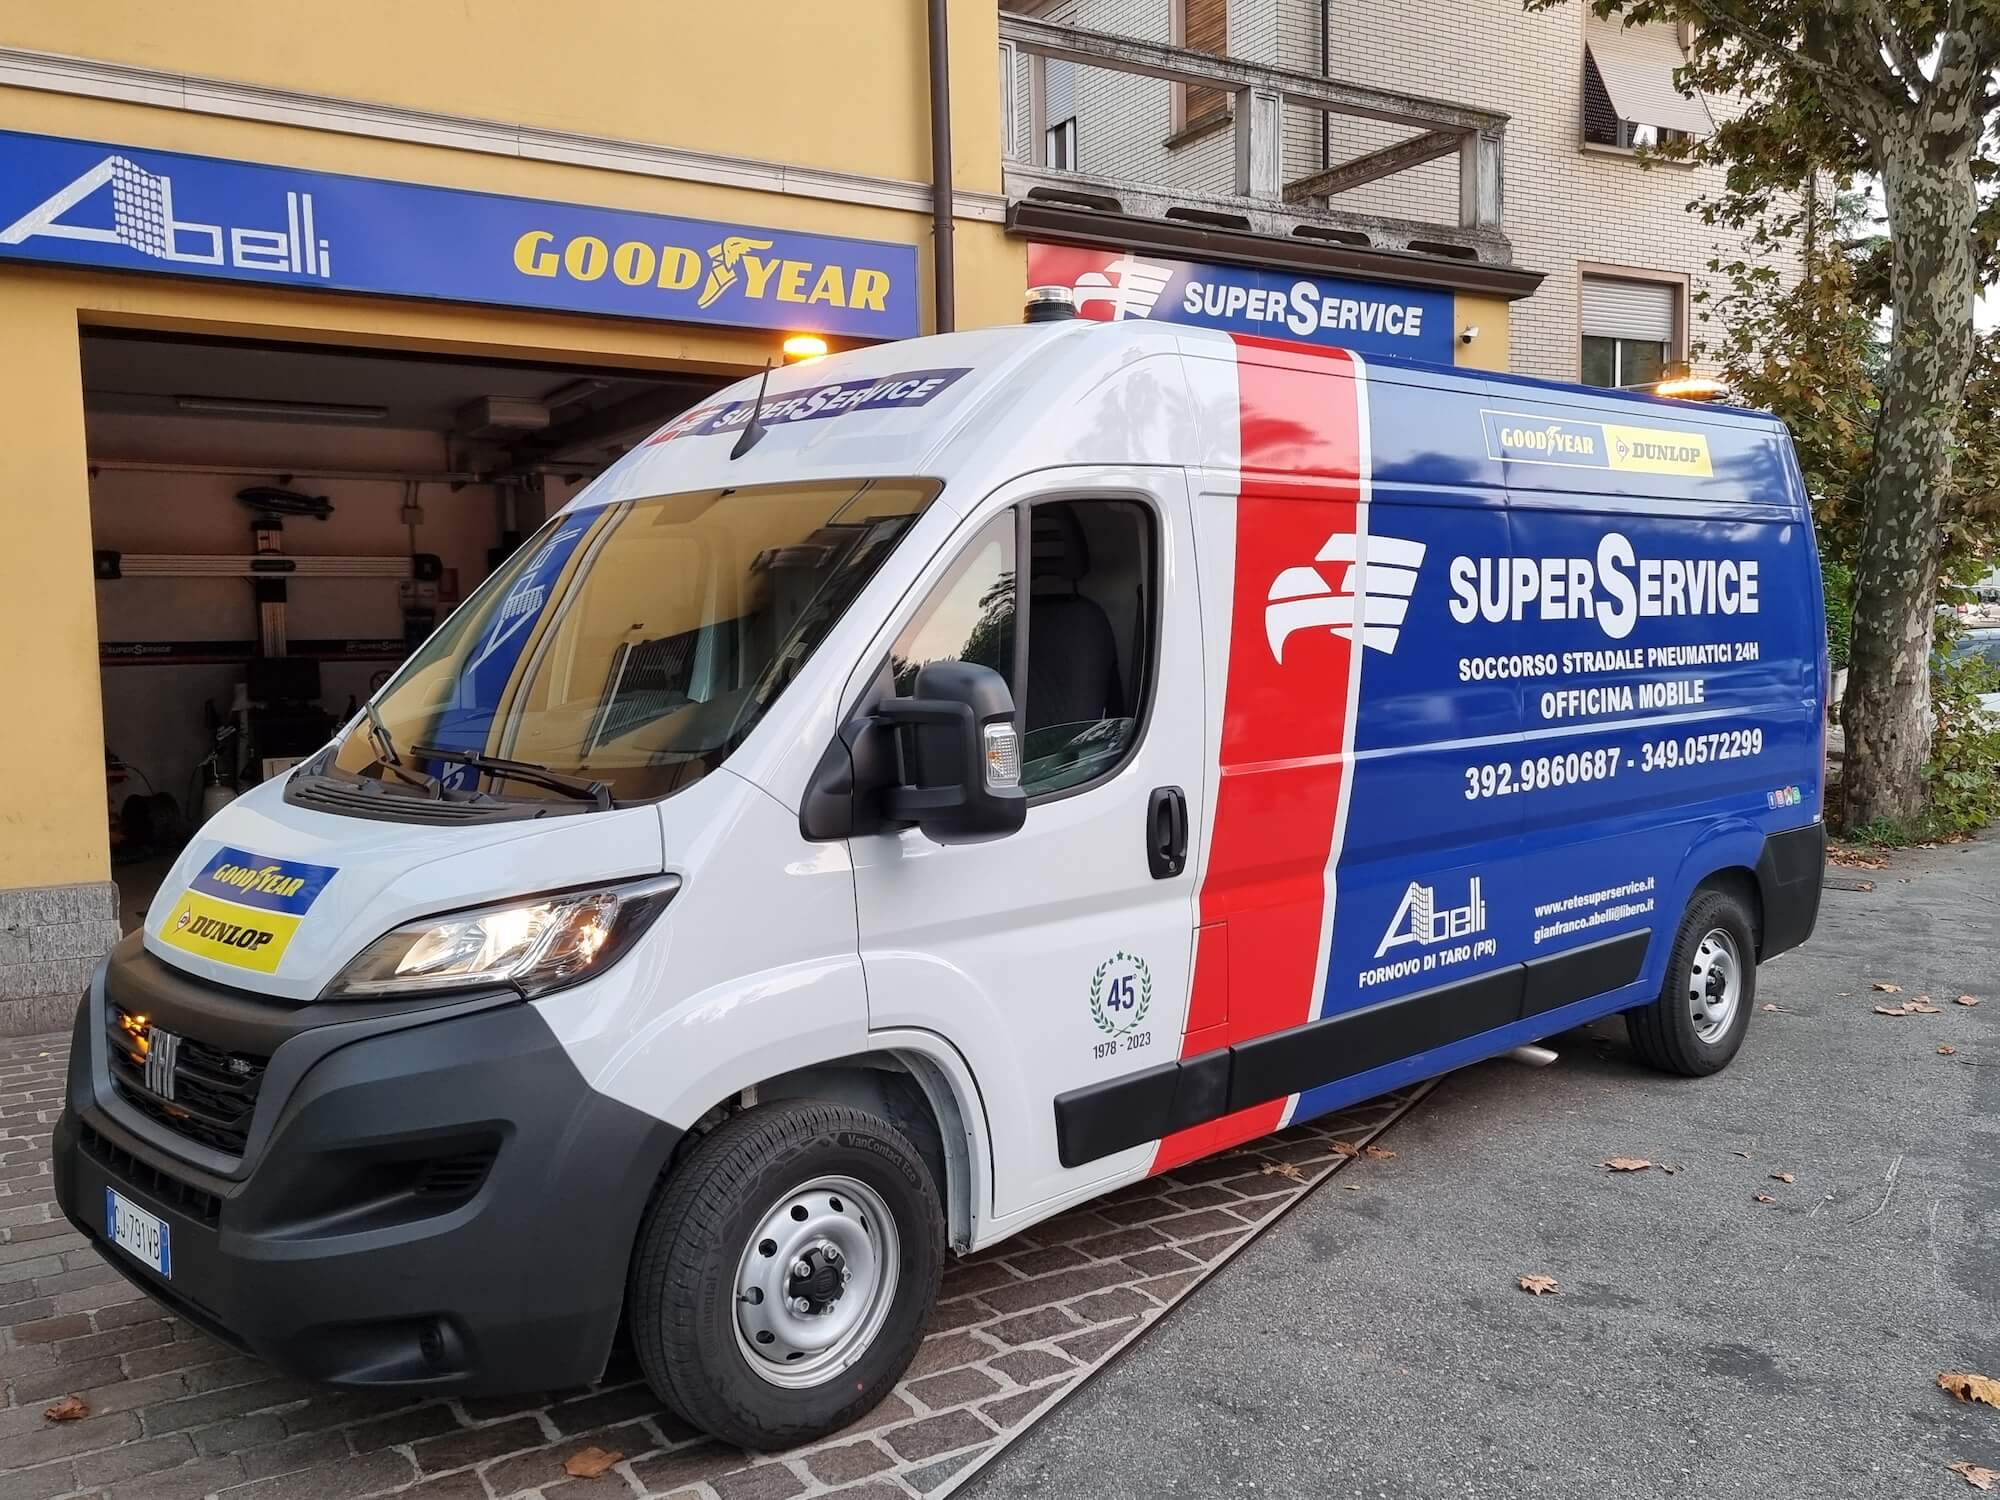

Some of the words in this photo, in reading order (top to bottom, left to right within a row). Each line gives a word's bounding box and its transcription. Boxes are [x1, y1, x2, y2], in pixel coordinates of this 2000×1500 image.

[0, 155, 330, 278] Abelli
[1183, 280, 1424, 337] SUPERSERVICE
[1632, 442, 1700, 463] DUNLOP
[1449, 533, 1760, 639] SUPERSERVICE
[1459, 654, 1558, 682] SOCCORSO
[1562, 648, 1644, 674] STRADALE
[1648, 643, 1732, 668] PNEUMATICI
[1735, 642, 1760, 662] 24H
[1541, 686, 1634, 720] OFFICINA
[1639, 679, 1705, 710] MOBILE
[1464, 747, 1621, 801] 392.9860687
[1641, 728, 1763, 773] 349.0572299
[1373, 876, 1486, 959] Abelli
[1534, 876, 1655, 918] www.retesuperservice.it
[1534, 898, 1654, 944] gianfranco.abelli@libero.it
[187, 915, 274, 951] DUNLOP
[1358, 961, 1420, 988] FORNOVO
[1423, 955, 1436, 971] DI
[1439, 944, 1471, 966] TARO
[1473, 938, 1497, 962] (PR)
[1093, 1040, 1117, 1060] 1978
[1127, 1032, 1151, 1051] 2023
[848, 1133, 902, 1168] VanContact
[902, 1162, 917, 1183] Eco
